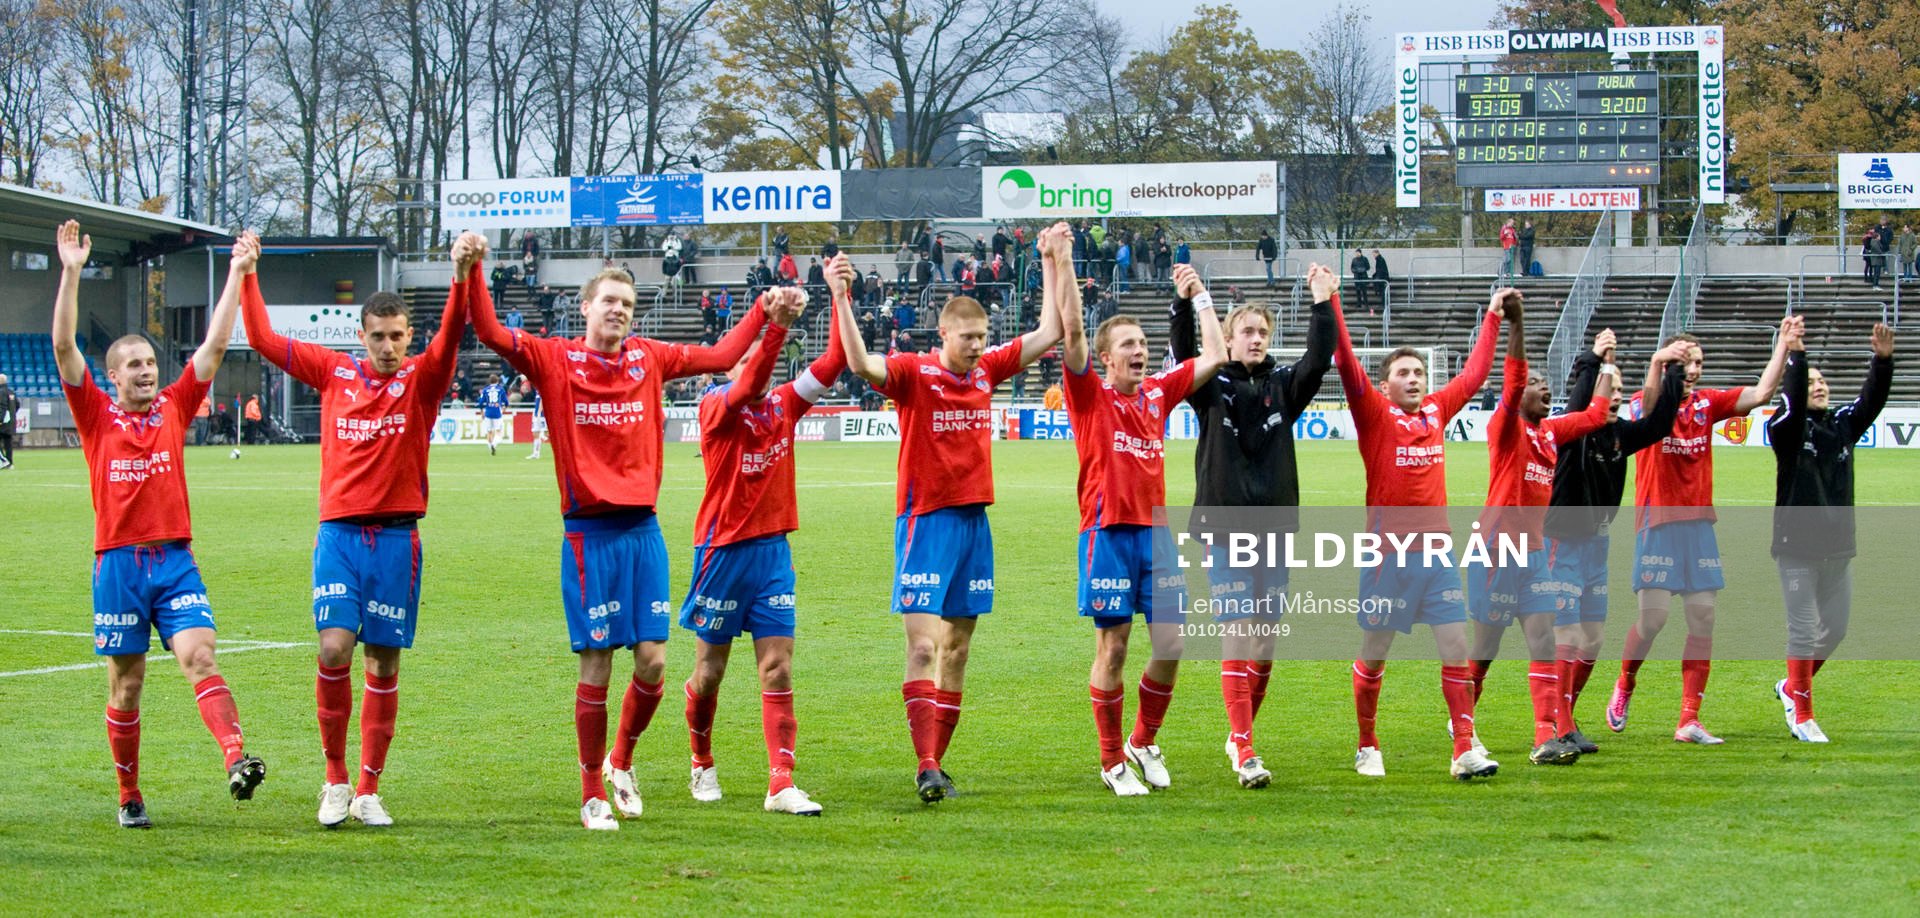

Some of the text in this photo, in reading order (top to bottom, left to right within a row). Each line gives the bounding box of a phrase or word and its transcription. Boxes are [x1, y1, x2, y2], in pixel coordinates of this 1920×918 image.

[1425, 34, 1505, 51] HSB HSB
[1511, 32, 1606, 50] OLYMPIA
[1613, 31, 1694, 47] HSB HSB
[1458, 79, 1467, 92] H
[1525, 77, 1534, 91] G
[1597, 75, 1636, 89] PUBLIK
[1471, 99, 1521, 117] 93:09
[1601, 97, 1647, 114] 9.200
[1398, 67, 1418, 196] nicorette
[1702, 61, 1721, 192] nicorette
[1130, 181, 1257, 201] elektrokoppar
[1847, 184, 1914, 194] BRIGGEN
[447, 189, 565, 208] coop FORUM
[1040, 183, 1112, 214] bring
[1530, 193, 1556, 207] HIF
[1570, 192, 1635, 207] LOTTEN!
[574, 401, 644, 414] RESURS
[575, 414, 622, 425] BANK
[933, 421, 972, 432] BANK
[337, 429, 378, 441] BANK
[803, 421, 826, 436] TAK
[1396, 445, 1444, 457] RESUR
[1395, 456, 1432, 467] BANK
[969, 579, 993, 592] SOL
[1091, 578, 1131, 590] SOLID
[696, 595, 738, 611] SOLID
[917, 592, 931, 606] 15
[95, 612, 139, 626] SOLID
[109, 632, 123, 648] 21
